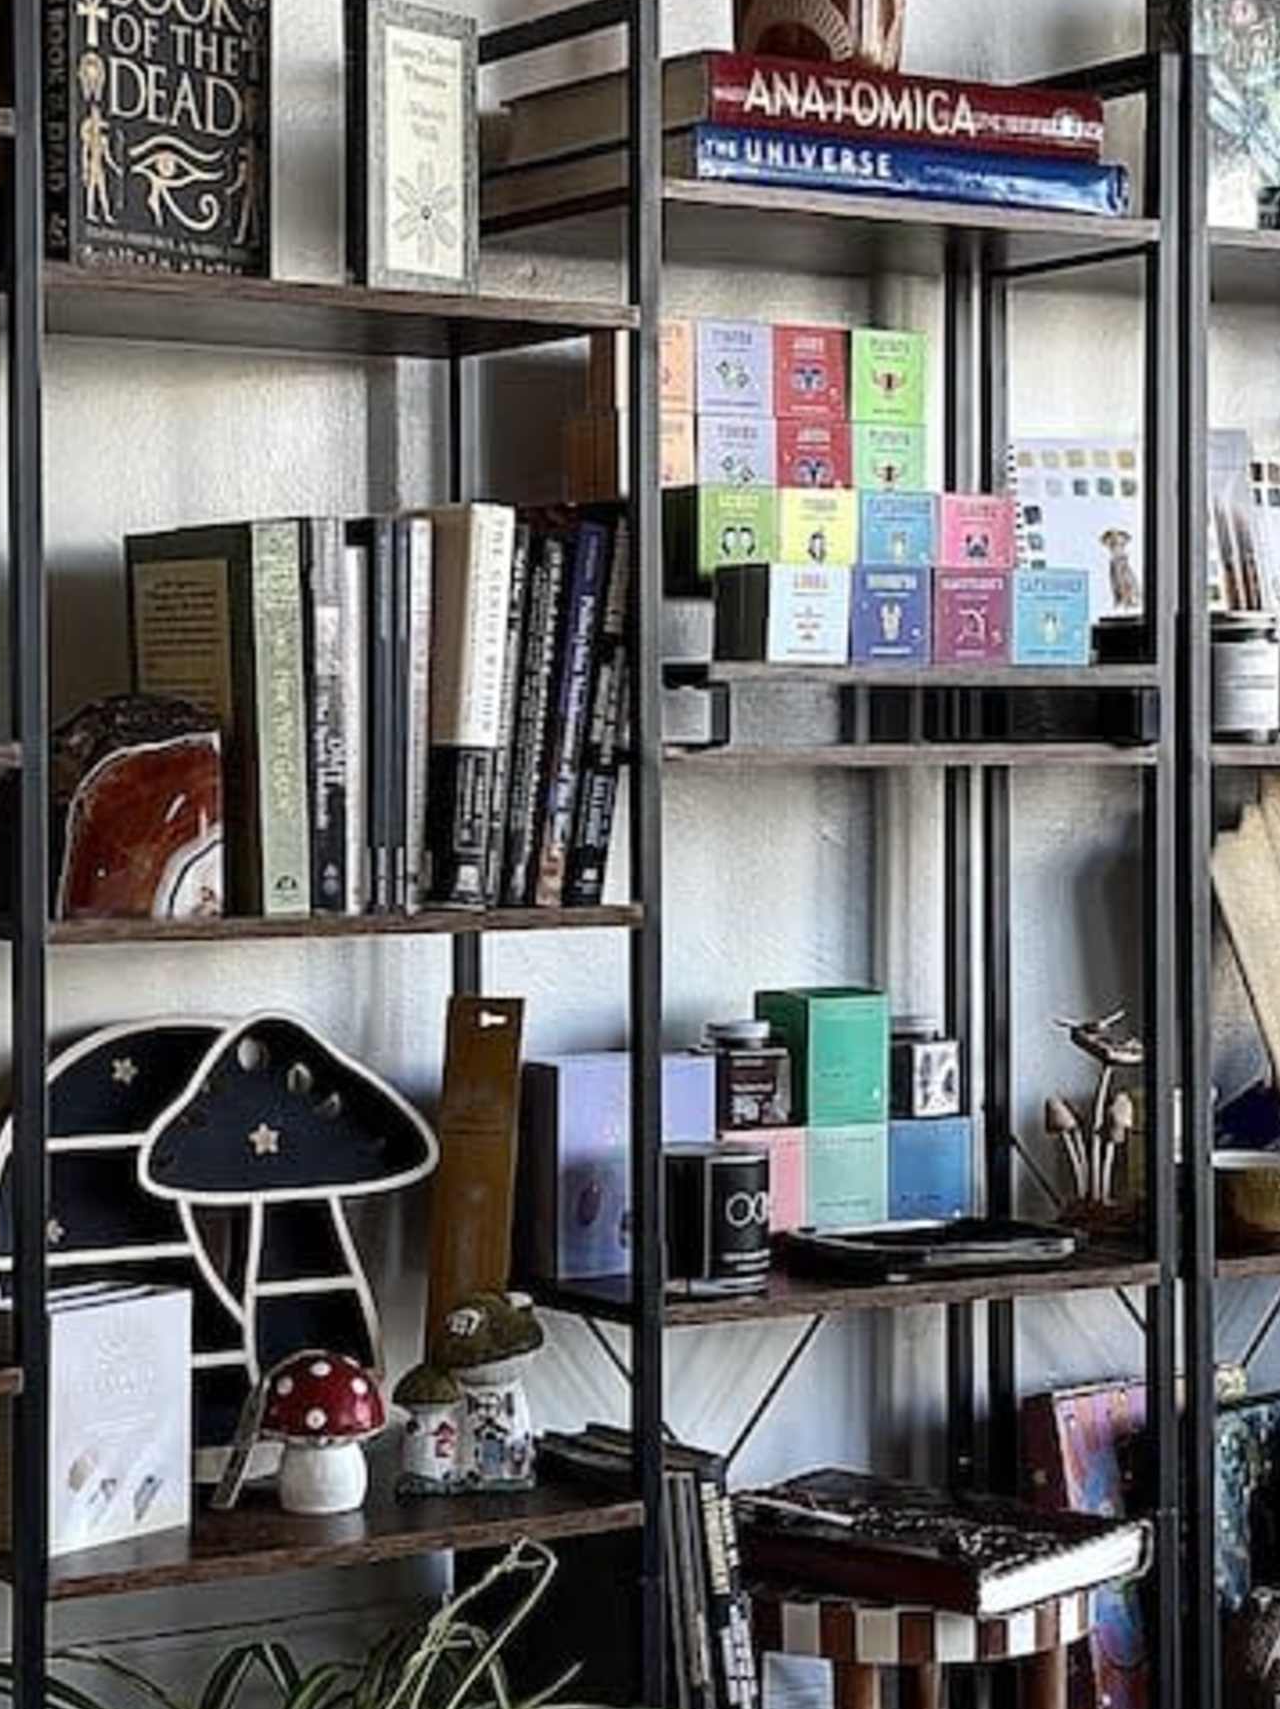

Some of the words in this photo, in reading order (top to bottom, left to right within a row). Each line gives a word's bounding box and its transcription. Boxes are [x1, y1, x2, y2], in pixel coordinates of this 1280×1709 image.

[110, 12, 160, 59] OF
[169, 23, 239, 77] THE
[108, 55, 243, 139] DEAD
[743, 70, 976, 138] ANATOMICA
[743, 137, 892, 179] UNIVERSE
